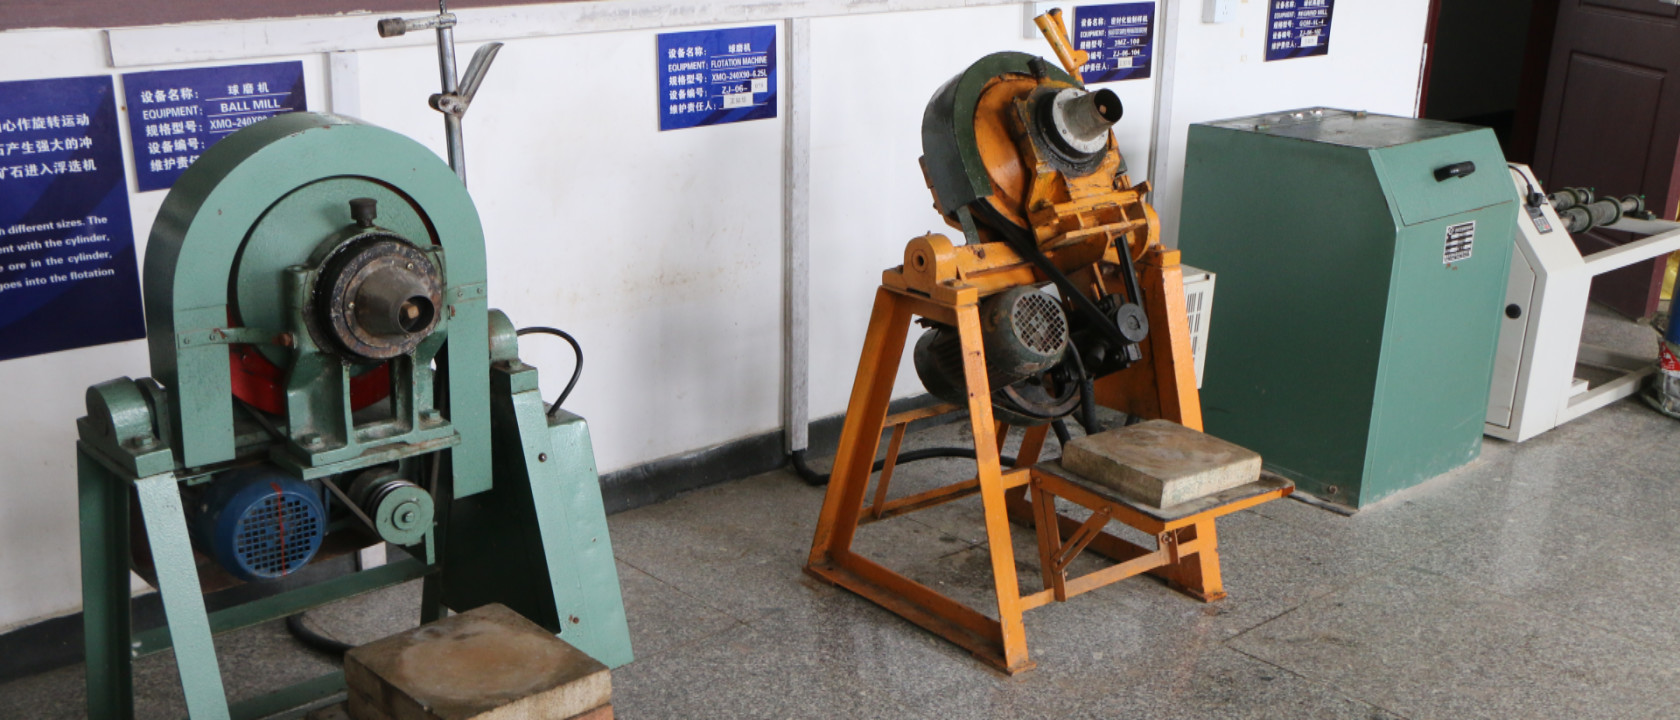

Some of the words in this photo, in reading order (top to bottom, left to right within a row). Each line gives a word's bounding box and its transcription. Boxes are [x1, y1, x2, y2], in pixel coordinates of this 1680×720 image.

[668, 61, 709, 72] EQUIPMENT:
[710, 59, 742, 69] FLOTATION
[742, 55, 768, 66] MACHINE
[142, 105, 203, 120] EQUIPMENT:
[220, 100, 251, 113] BALL
[252, 98, 281, 110] MILL
[0, 113, 90, 133] 心作旋转运动
[7, 222, 55, 235] different
[86, 215, 108, 225] The
[17, 240, 43, 252] with
[44, 239, 63, 249] the
[8, 262, 27, 271] ore
[30, 258, 42, 268] in
[45, 256, 64, 266] the
[25, 277, 48, 287] into
[49, 273, 68, 283] the
[70, 267, 116, 280] flotation
